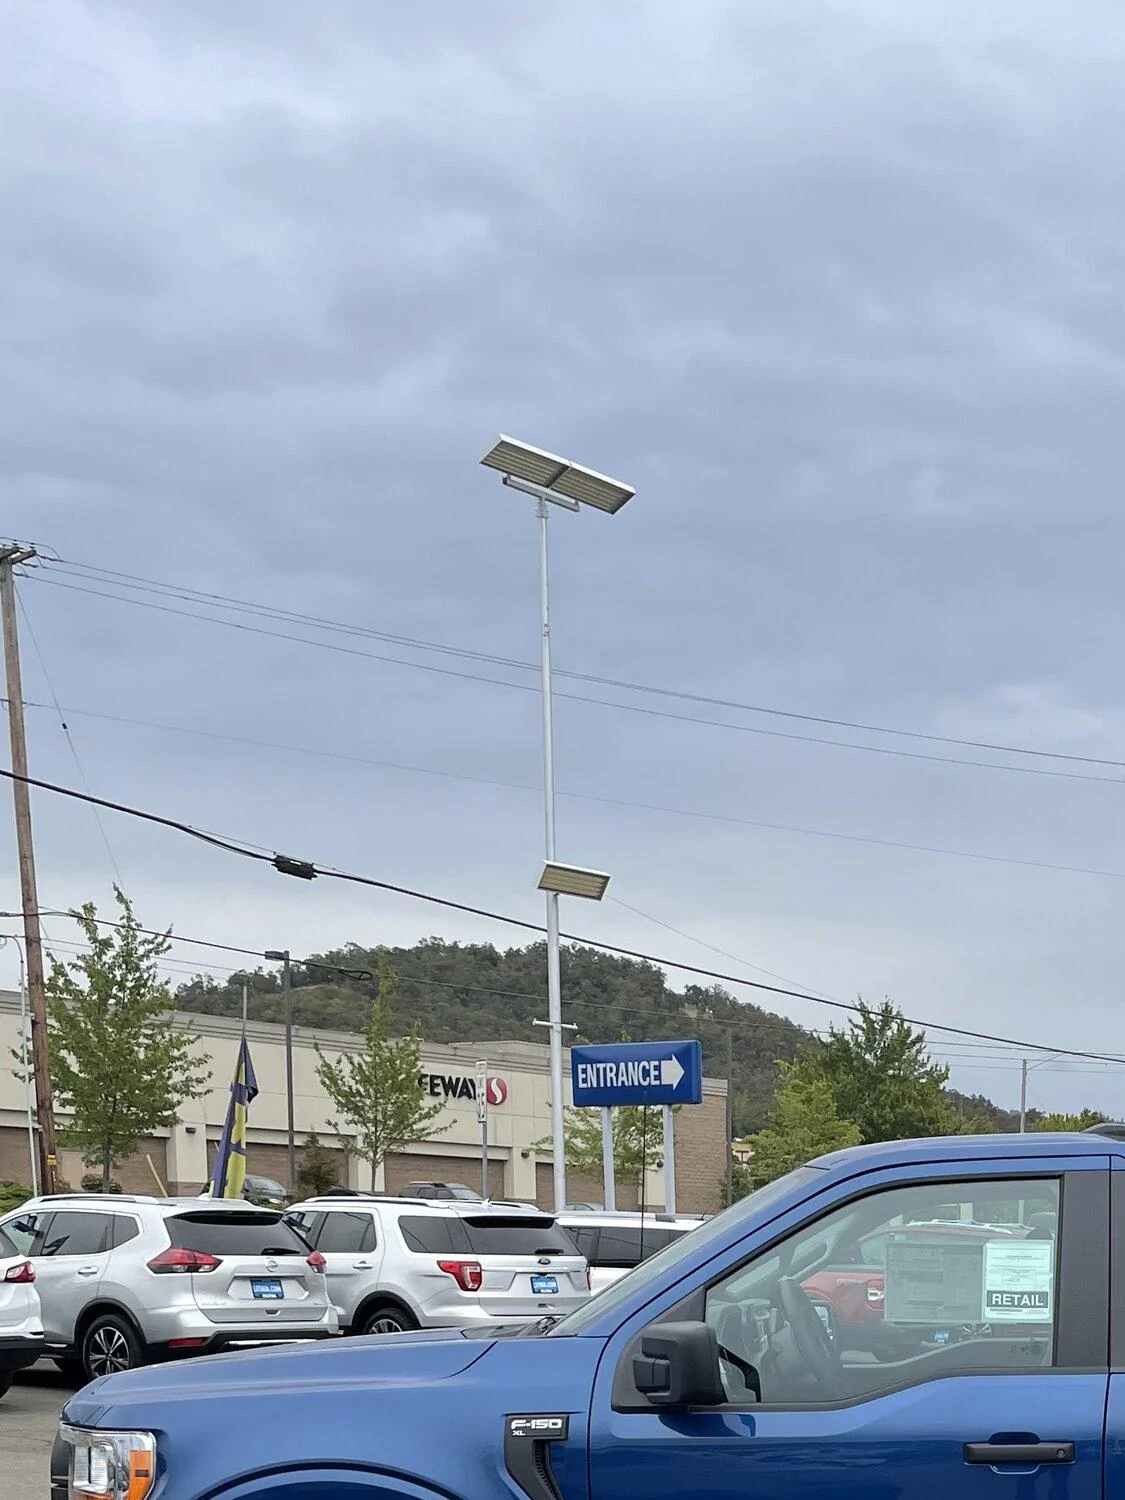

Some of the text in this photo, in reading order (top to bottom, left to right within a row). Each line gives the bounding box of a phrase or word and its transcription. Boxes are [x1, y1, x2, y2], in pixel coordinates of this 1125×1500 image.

[577, 1060, 661, 1089] ENTRANCE
[991, 1292, 1044, 1307] RETAIL
[510, 1418, 563, 1430] F-150
